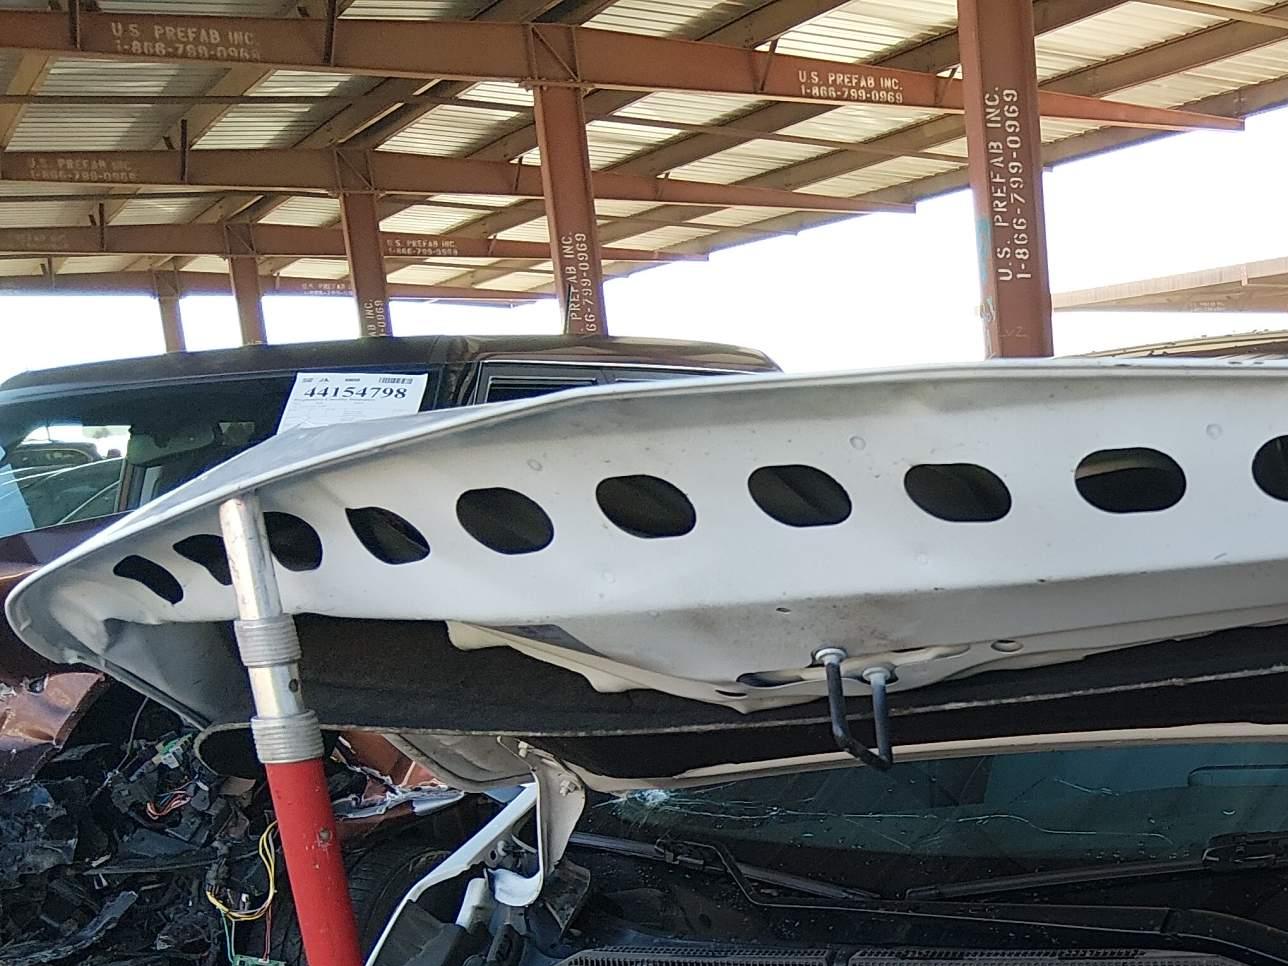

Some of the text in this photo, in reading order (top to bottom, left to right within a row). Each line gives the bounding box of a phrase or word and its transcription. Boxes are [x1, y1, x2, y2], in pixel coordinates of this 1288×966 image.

[154, 25, 221, 43] PREFAB
[828, 72, 875, 88] PREFAB
[880, 77, 903, 90] INC.
[800, 84, 903, 103] 1-866-799-0969
[985, 87, 1013, 281] U.S. PREFAB INC.
[1003, 89, 1032, 279] 1-866-799-0969
[561, 231, 576, 258] INC.
[304, 386, 408, 399] 44154798
